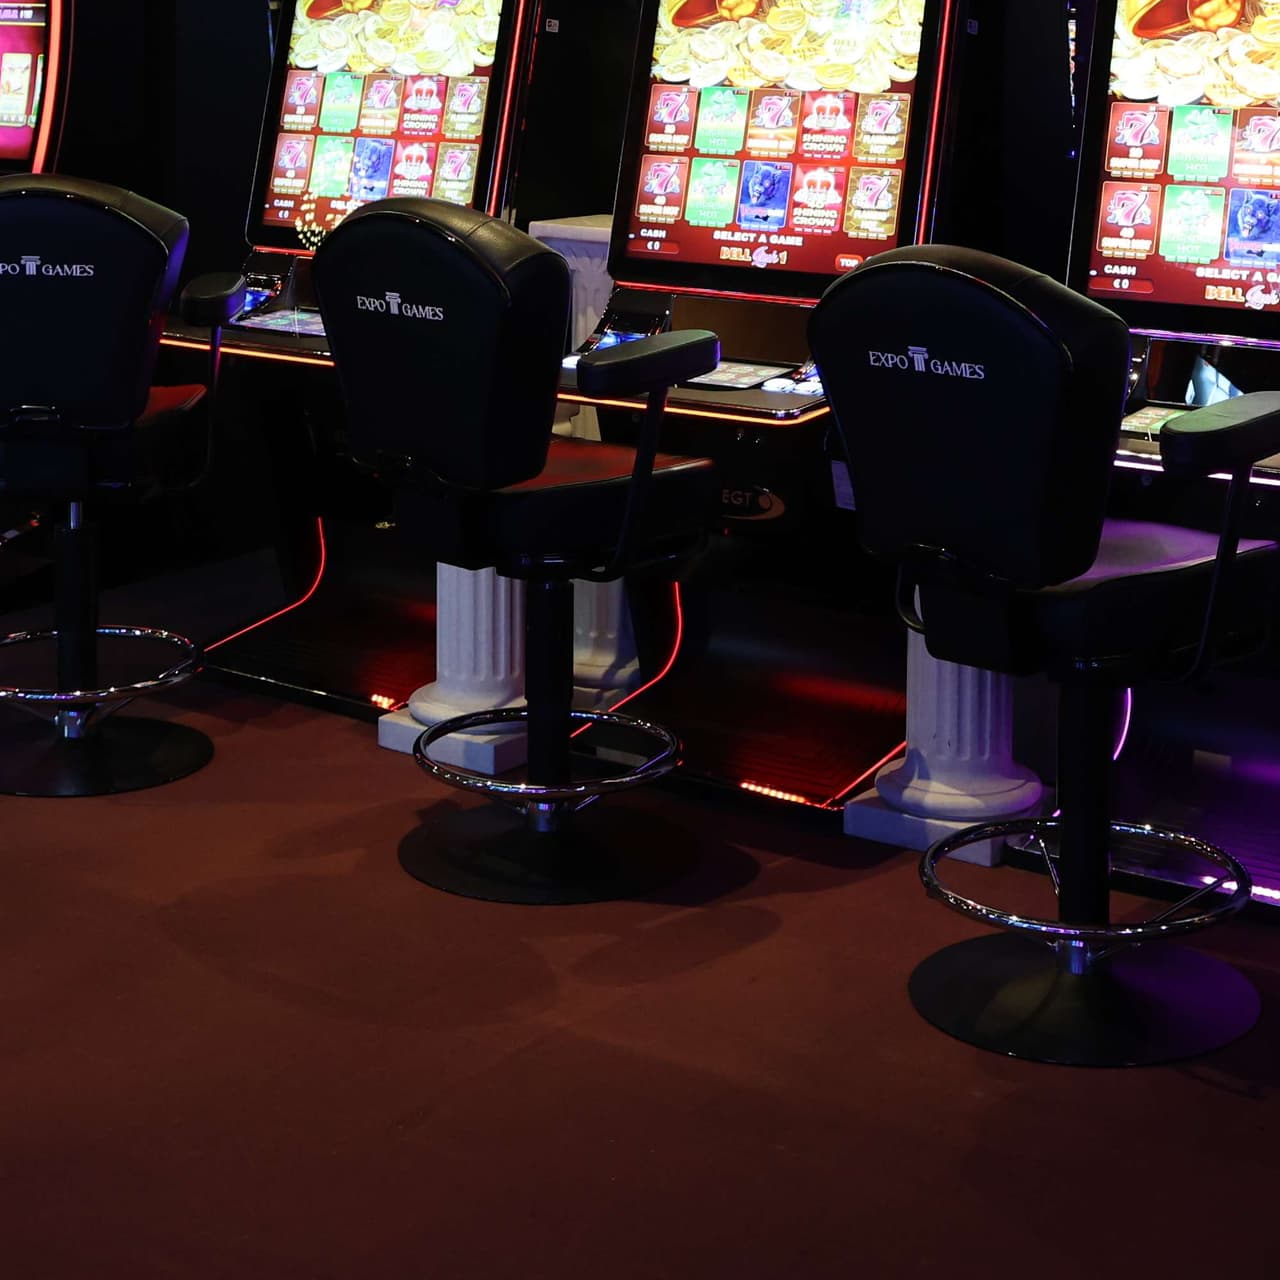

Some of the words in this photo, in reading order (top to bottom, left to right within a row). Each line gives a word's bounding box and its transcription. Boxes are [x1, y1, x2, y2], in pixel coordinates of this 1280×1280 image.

[640, 228, 666, 239] CASH
[713, 230, 757, 243] SELECT
[758, 233, 767, 243] A
[769, 235, 803, 246] GAME
[42, 264, 94, 276] GAMES
[1104, 264, 1136, 275] CASH
[1196, 267, 1249, 280] SELECT
[1252, 271, 1263, 281] A
[1205, 285, 1245, 302] BELL
[357, 296, 386, 312] EXPO
[402, 303, 444, 320] GAMES
[869, 351, 908, 369] EXPO
[930, 360, 984, 379] GAMES
